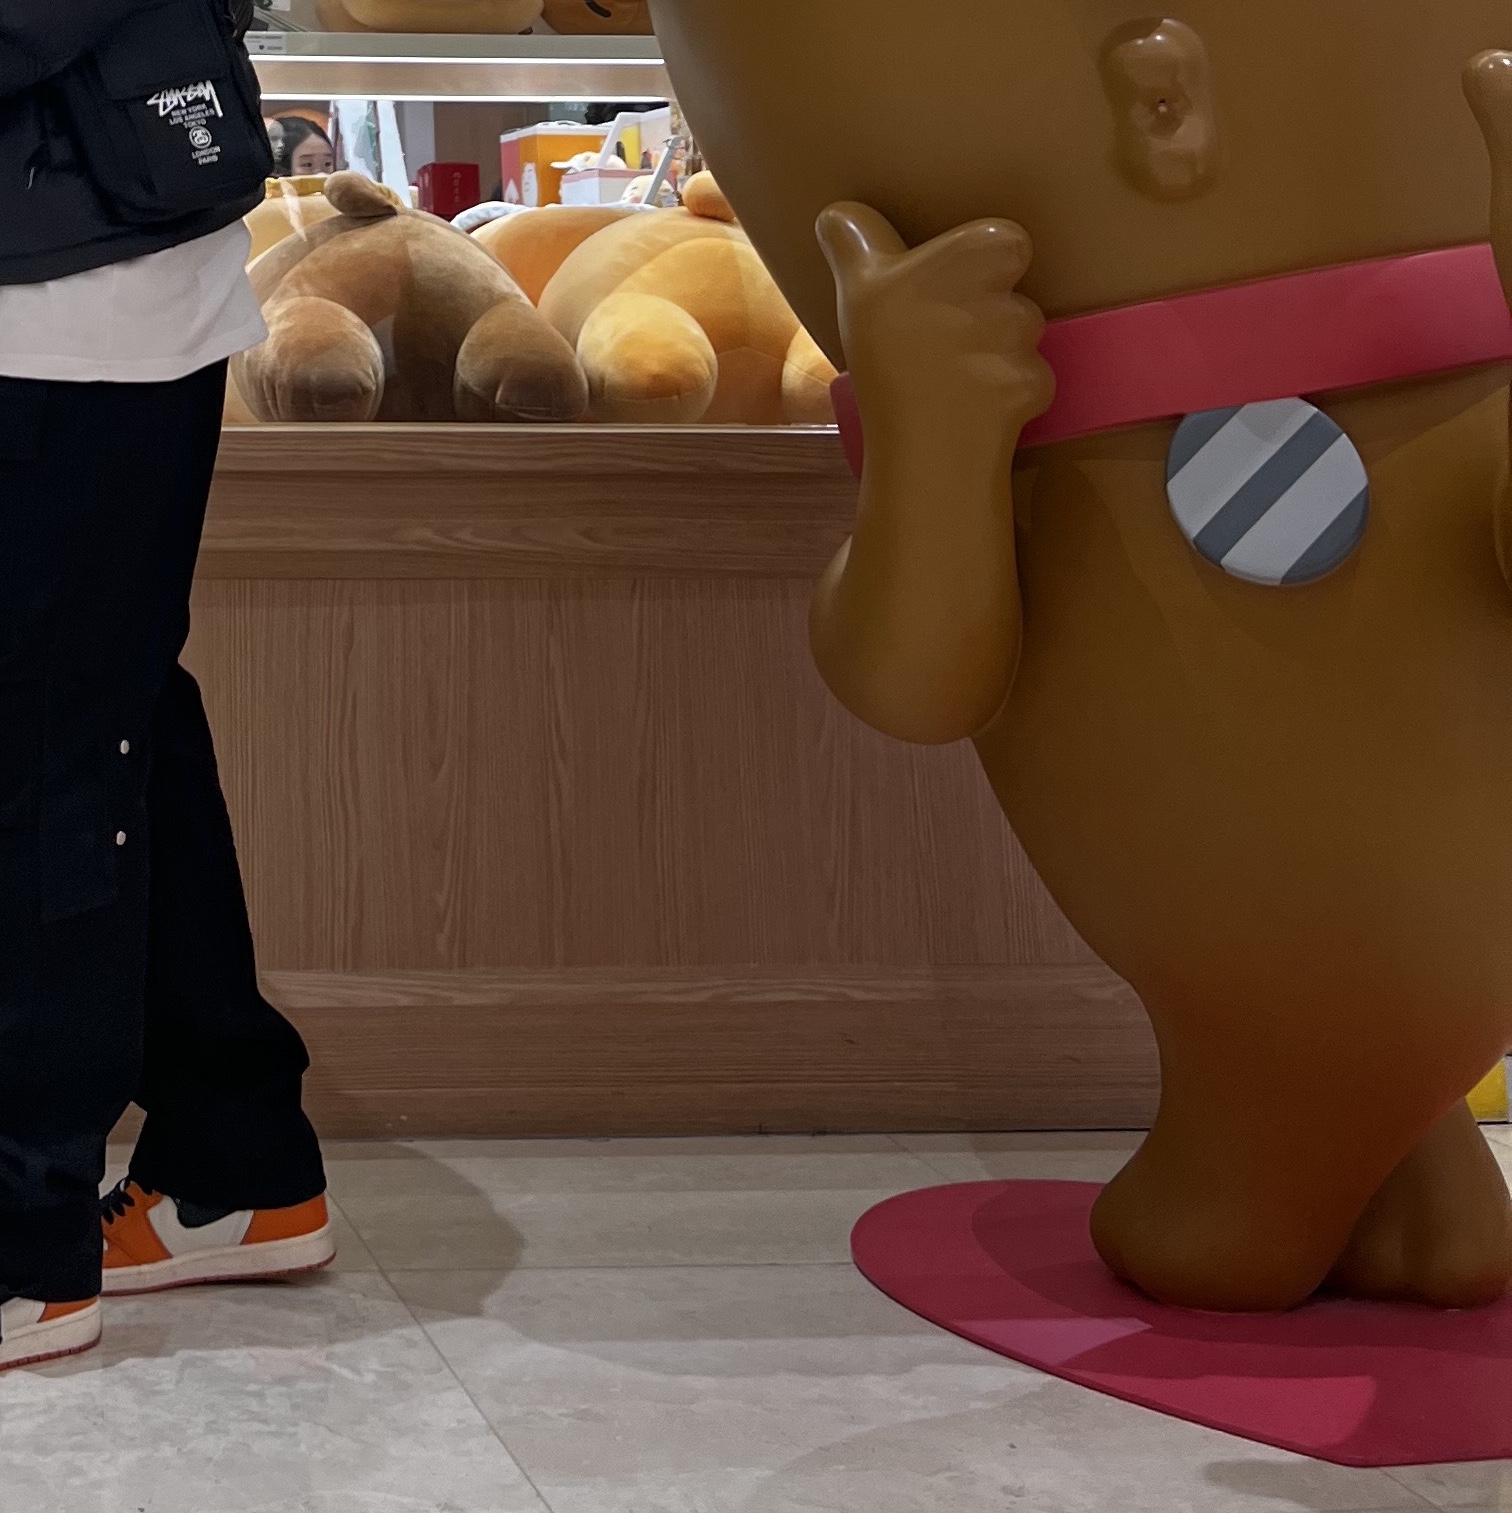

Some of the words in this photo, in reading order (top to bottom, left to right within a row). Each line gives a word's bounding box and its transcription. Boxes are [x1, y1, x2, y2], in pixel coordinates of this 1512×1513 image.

[169, 116, 184, 125] LOS
[184, 108, 215, 121] ANGELES
[171, 108, 187, 117] NEW
[187, 103, 208, 113] YORK
[183, 118, 207, 128] TOKYO
[191, 145, 221, 159] LONDON
[198, 154, 219, 165] PARIS
